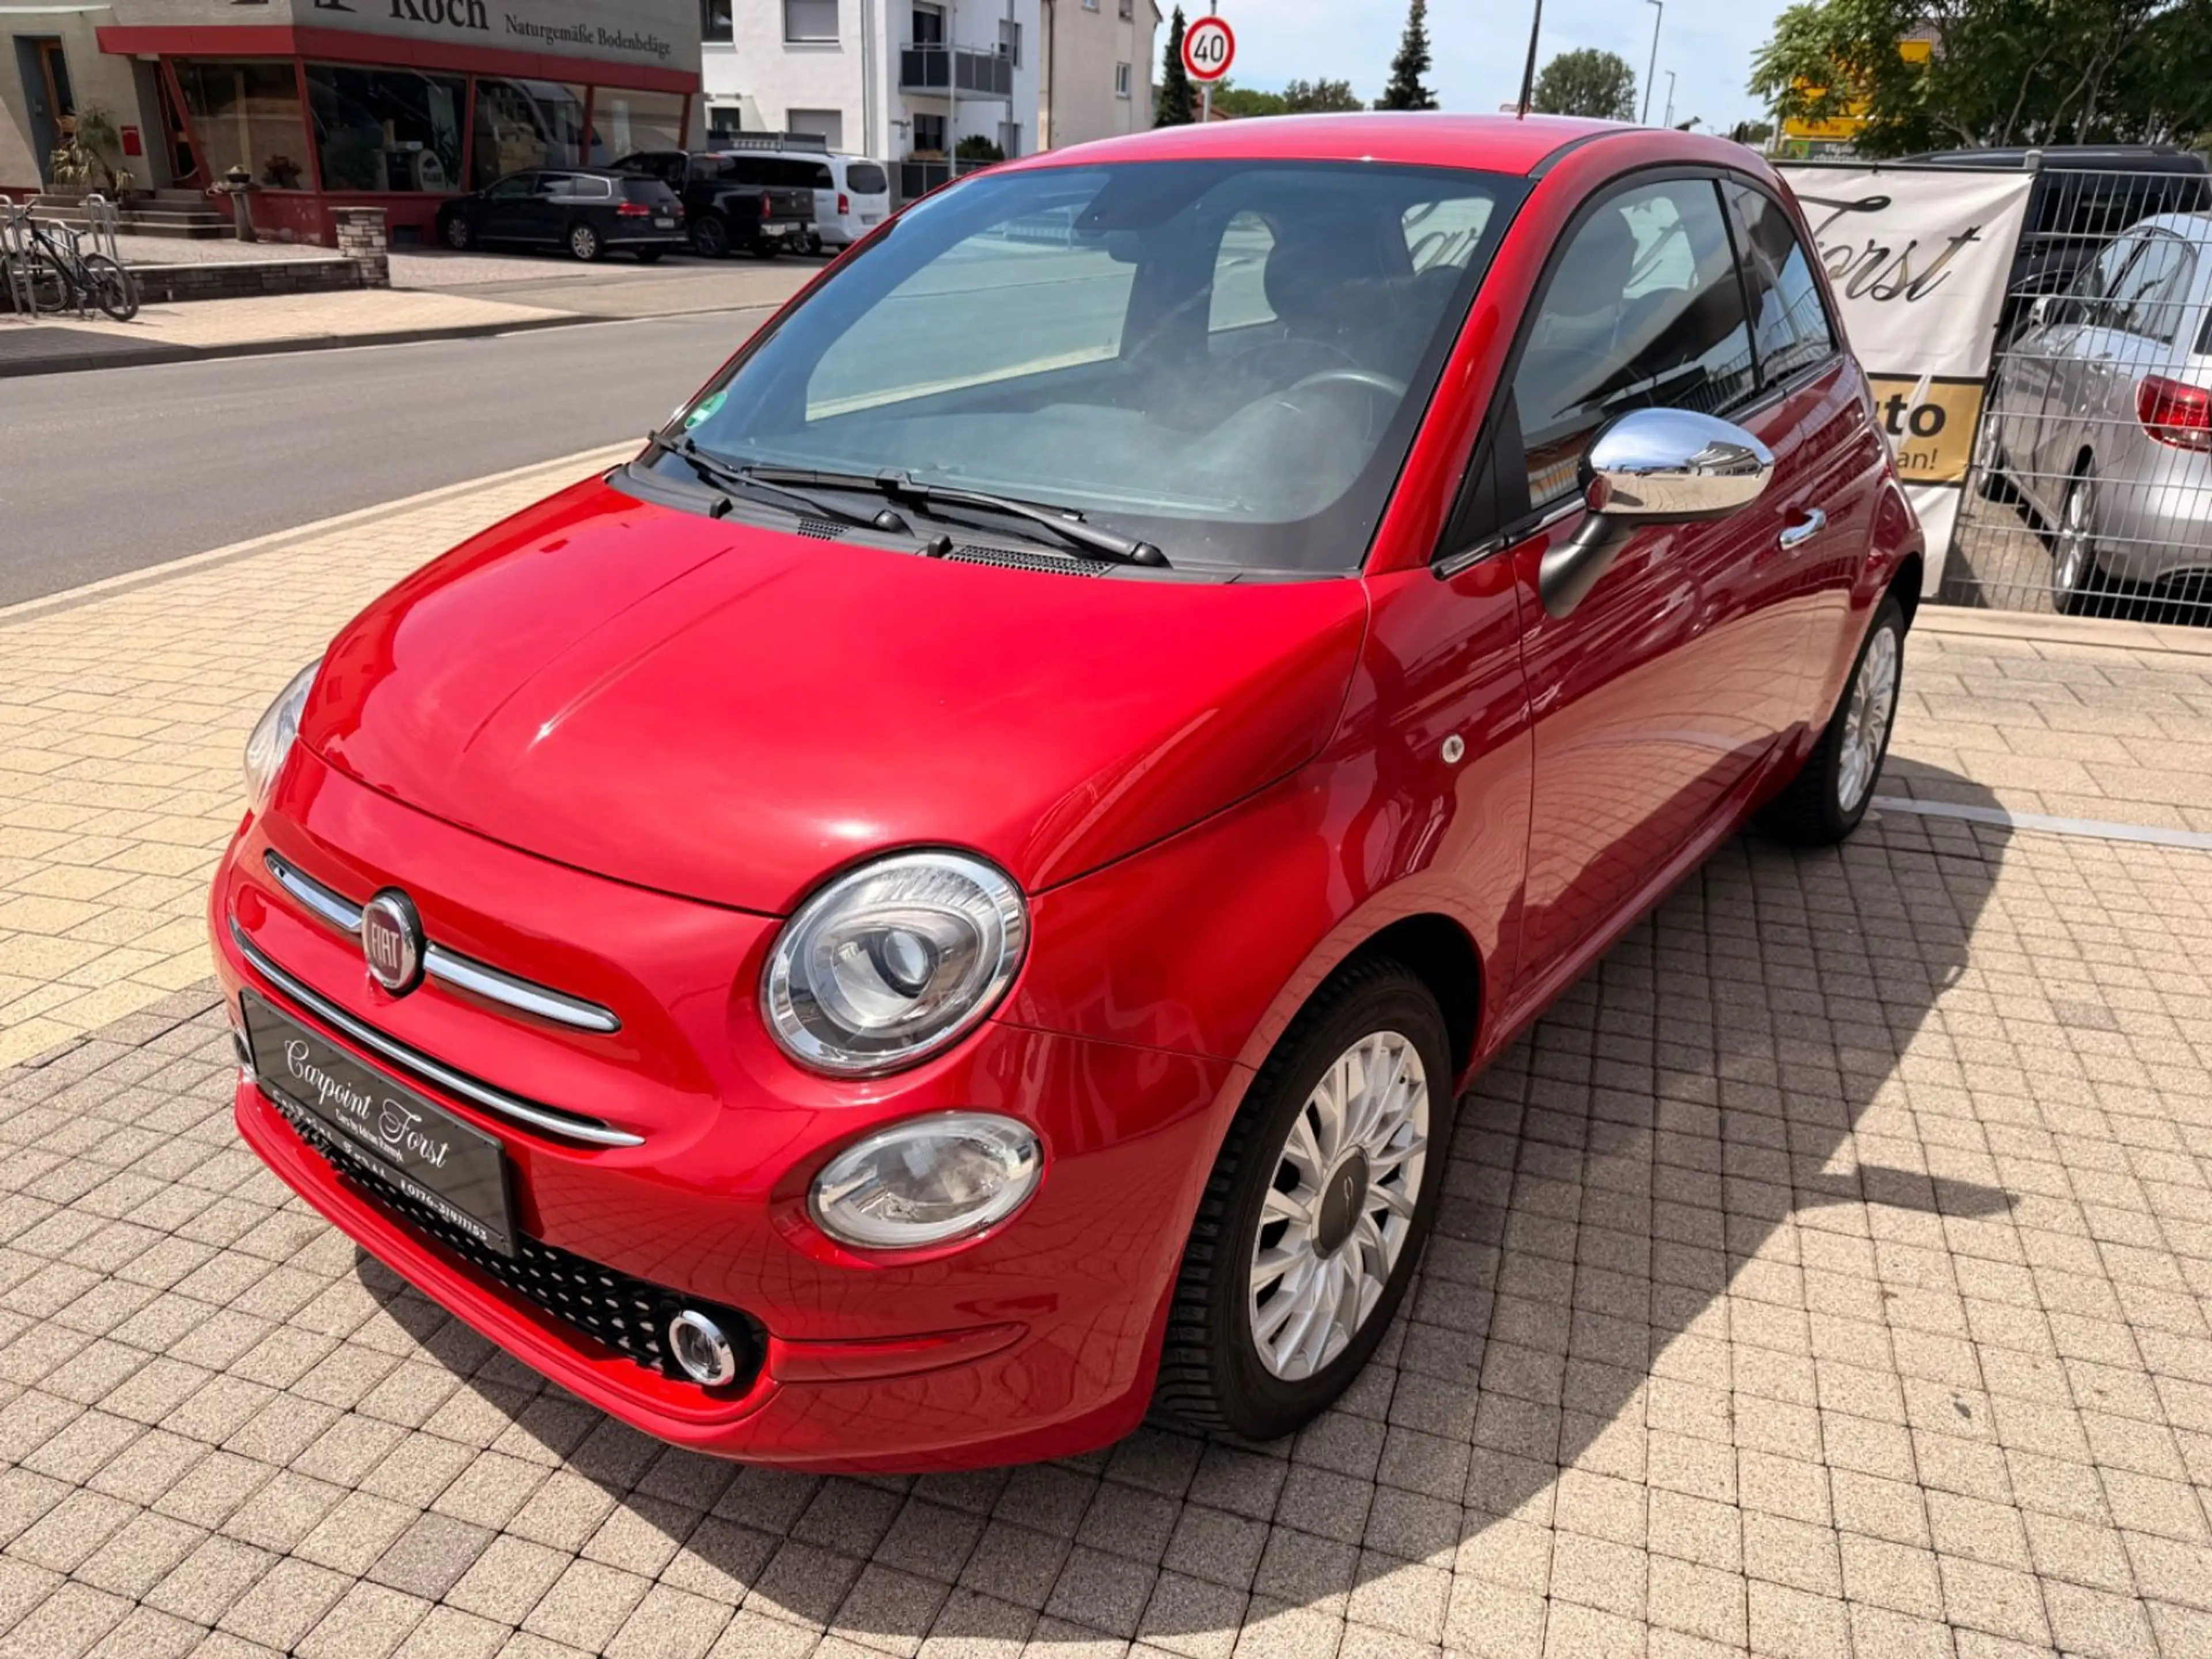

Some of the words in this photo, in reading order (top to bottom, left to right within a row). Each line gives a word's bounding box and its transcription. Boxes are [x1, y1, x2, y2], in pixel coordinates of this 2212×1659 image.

[504, 12, 594, 45] Naturgemäße
[597, 27, 672, 60] Bodenbeläge
[1193, 35, 1224, 63] 40
[1875, 393, 1946, 438] to
[371, 922, 400, 969] FIAT
[285, 1040, 373, 1120] Carpoint
[378, 1098, 450, 1168] Forst
